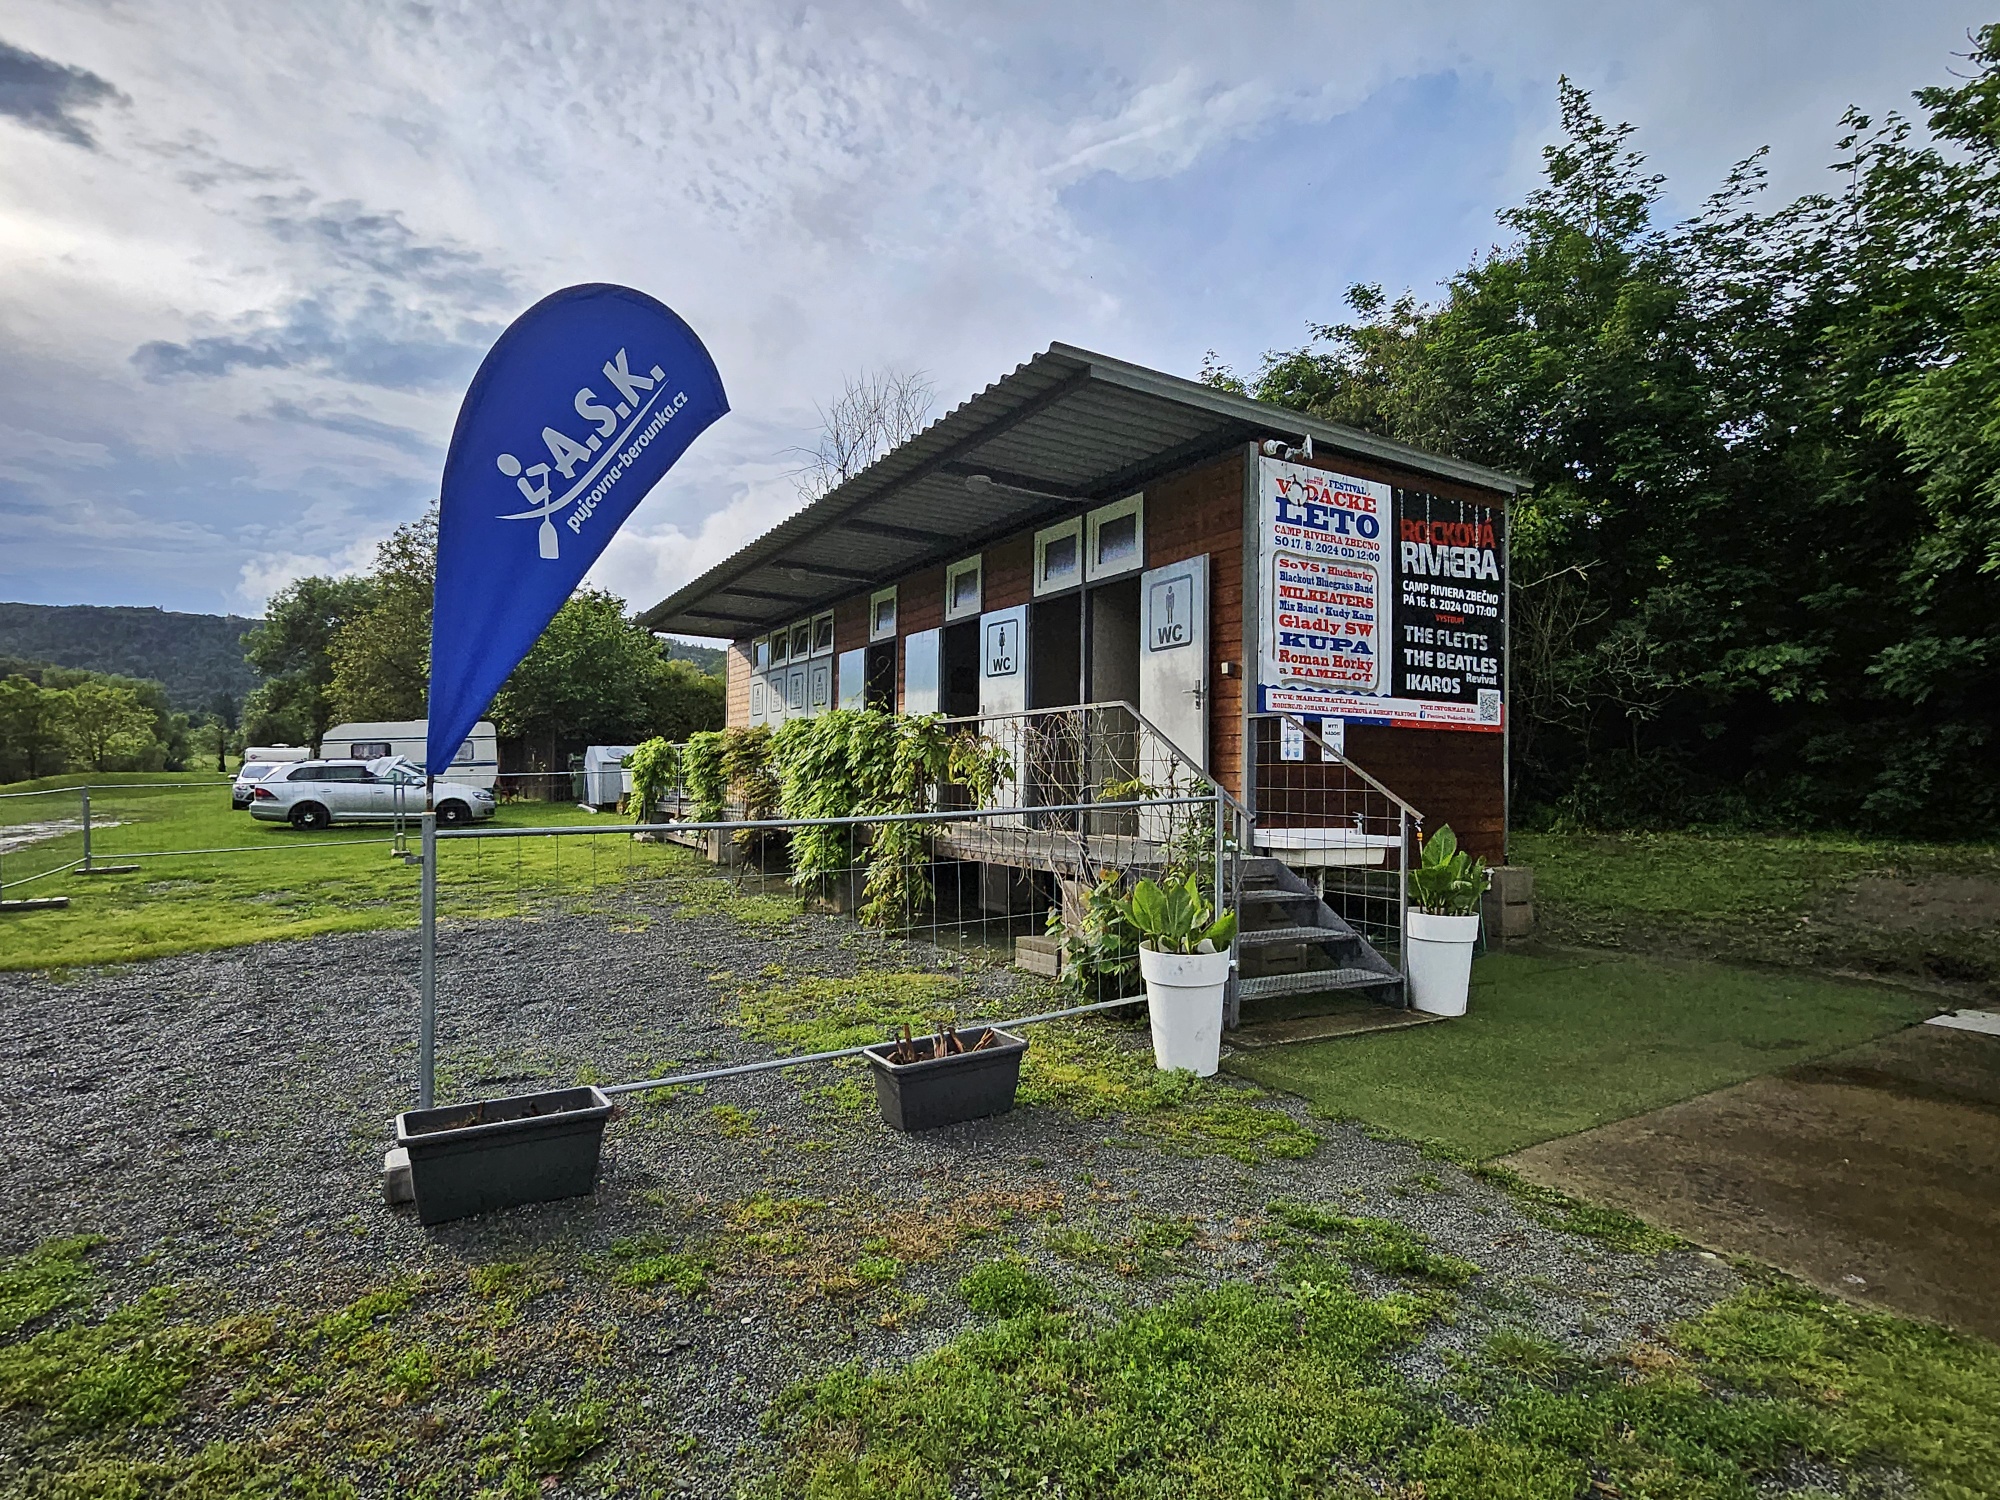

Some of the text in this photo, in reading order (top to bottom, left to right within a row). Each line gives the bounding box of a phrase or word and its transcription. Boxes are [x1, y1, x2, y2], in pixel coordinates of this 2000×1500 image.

[542, 348, 666, 479] A.S.K.
[567, 391, 689, 534] pujcovna-berounka.cz
[1329, 480, 1366, 495] FESTIVAL
[1274, 525, 1302, 536] CAMP
[1303, 530, 1343, 544] RIVIERA
[1400, 516, 1496, 548] ROCKOVÁ
[1274, 536, 1380, 562] SO 17. 8. 2024 OD 12:00
[1400, 541, 1500, 580] RIVIERA
[1280, 571, 1374, 594] Blackout Bluegrass Band
[1328, 566, 1374, 582] Hluchavky
[1280, 585, 1374, 609] MILKEATERS
[1402, 580, 1498, 604] CAMP RIVIERA ZBEČNO
[1280, 600, 1374, 622] Mix Band Kudy Kam
[1403, 592, 1498, 617] PÁ 16. 8. 2024 OD 17:00
[1158, 624, 1183, 644] WC
[1279, 614, 1374, 637] Gladly SW
[1280, 632, 1374, 655] KUPA
[1404, 624, 1488, 651] THE FLETTS
[992, 656, 1011, 672] WC
[1279, 650, 1374, 672] Roman Horký
[1404, 648, 1498, 674] THE BEATLES
[1292, 667, 1373, 682] KAMELOT
[1406, 674, 1461, 694] IKAROS
[1466, 672, 1498, 685] Revival
